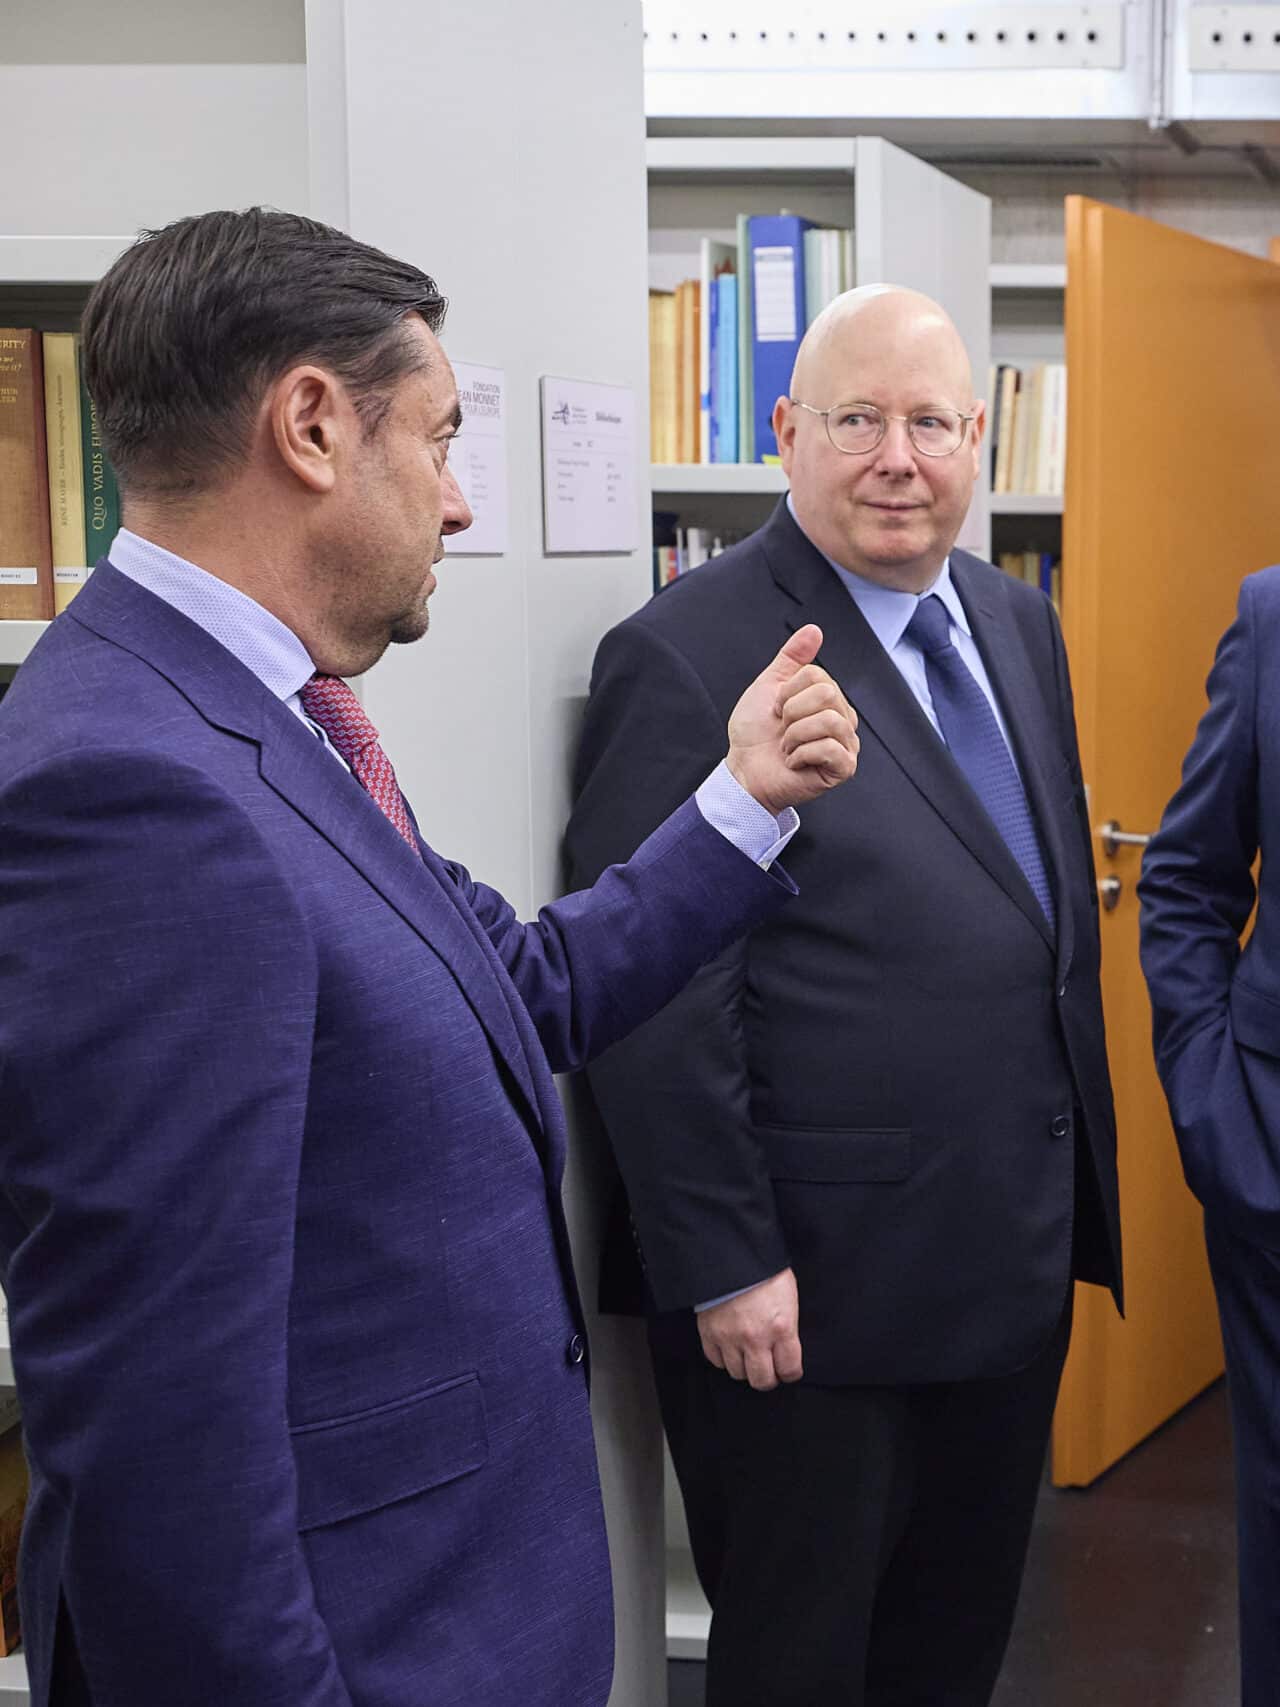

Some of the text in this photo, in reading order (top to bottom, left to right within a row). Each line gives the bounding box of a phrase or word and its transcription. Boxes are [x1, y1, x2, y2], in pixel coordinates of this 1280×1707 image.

[458, 390, 500, 406] EAN MONNET
[92, 453, 104, 491] VADIS
[91, 496, 107, 531] QUO
